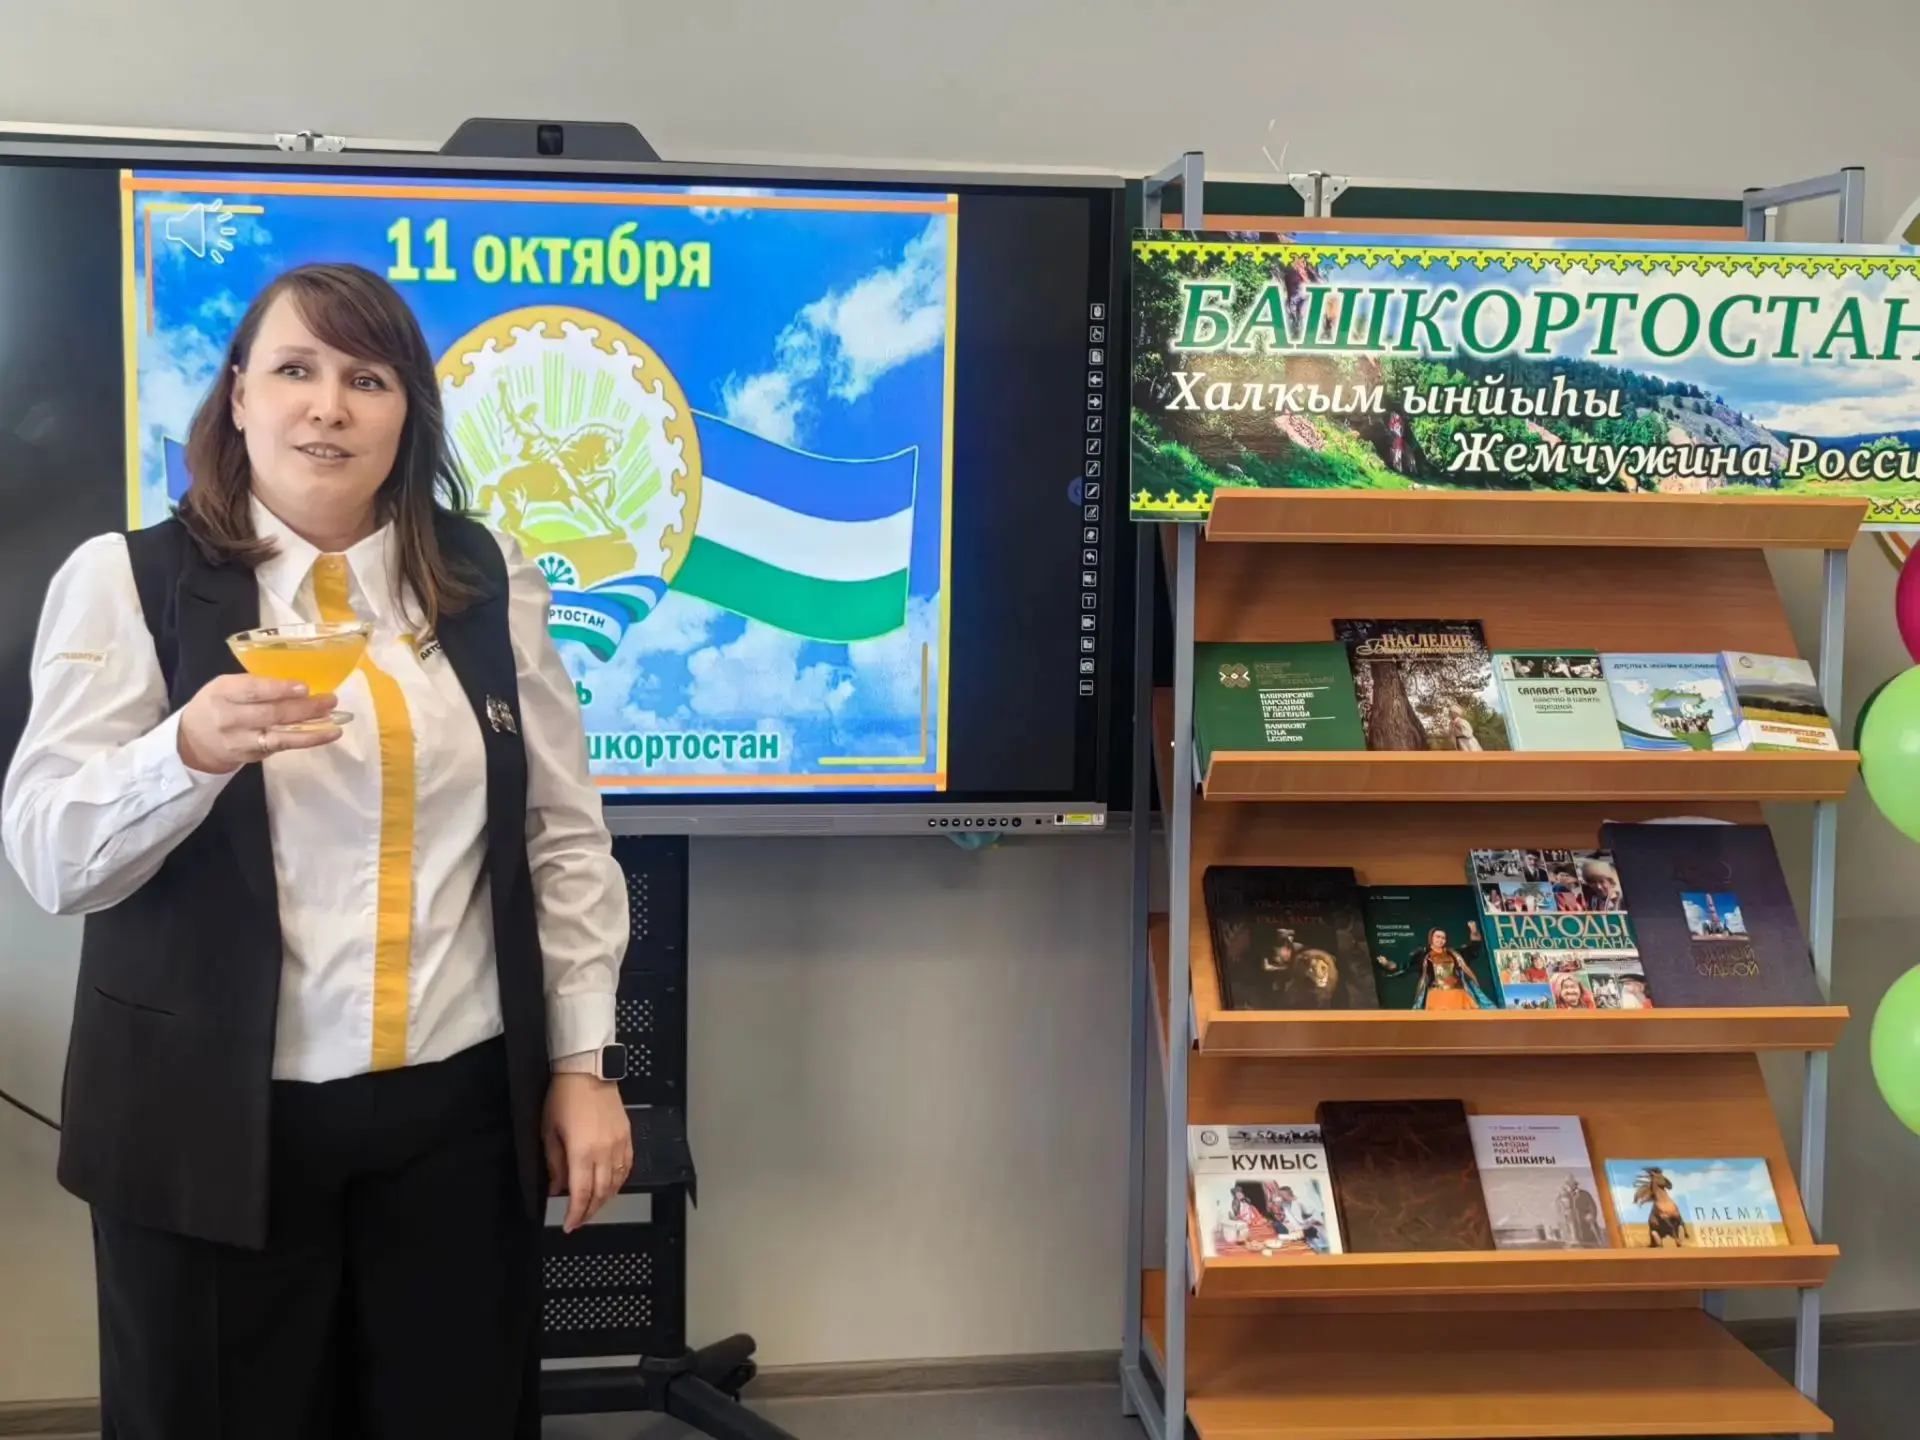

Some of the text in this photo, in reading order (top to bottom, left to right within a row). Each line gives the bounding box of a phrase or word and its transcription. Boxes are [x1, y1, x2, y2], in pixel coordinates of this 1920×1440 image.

[387, 217, 712, 302] 11 октября
[1173, 283, 1920, 362] БАШКОРТОСТАН
[1402, 373, 1624, 419] ынйыһы
[1446, 431, 1773, 486] Жемчужина
[1493, 914, 1630, 938] НАРОДЫ
[1498, 937, 1637, 949] БАШКОРТОСТАНА
[1231, 1153, 1319, 1171] КУМЫС
[1495, 1156, 1556, 1165] БАШКИРЫ
[1694, 1206, 1765, 1221] ПЛЕМЯ
